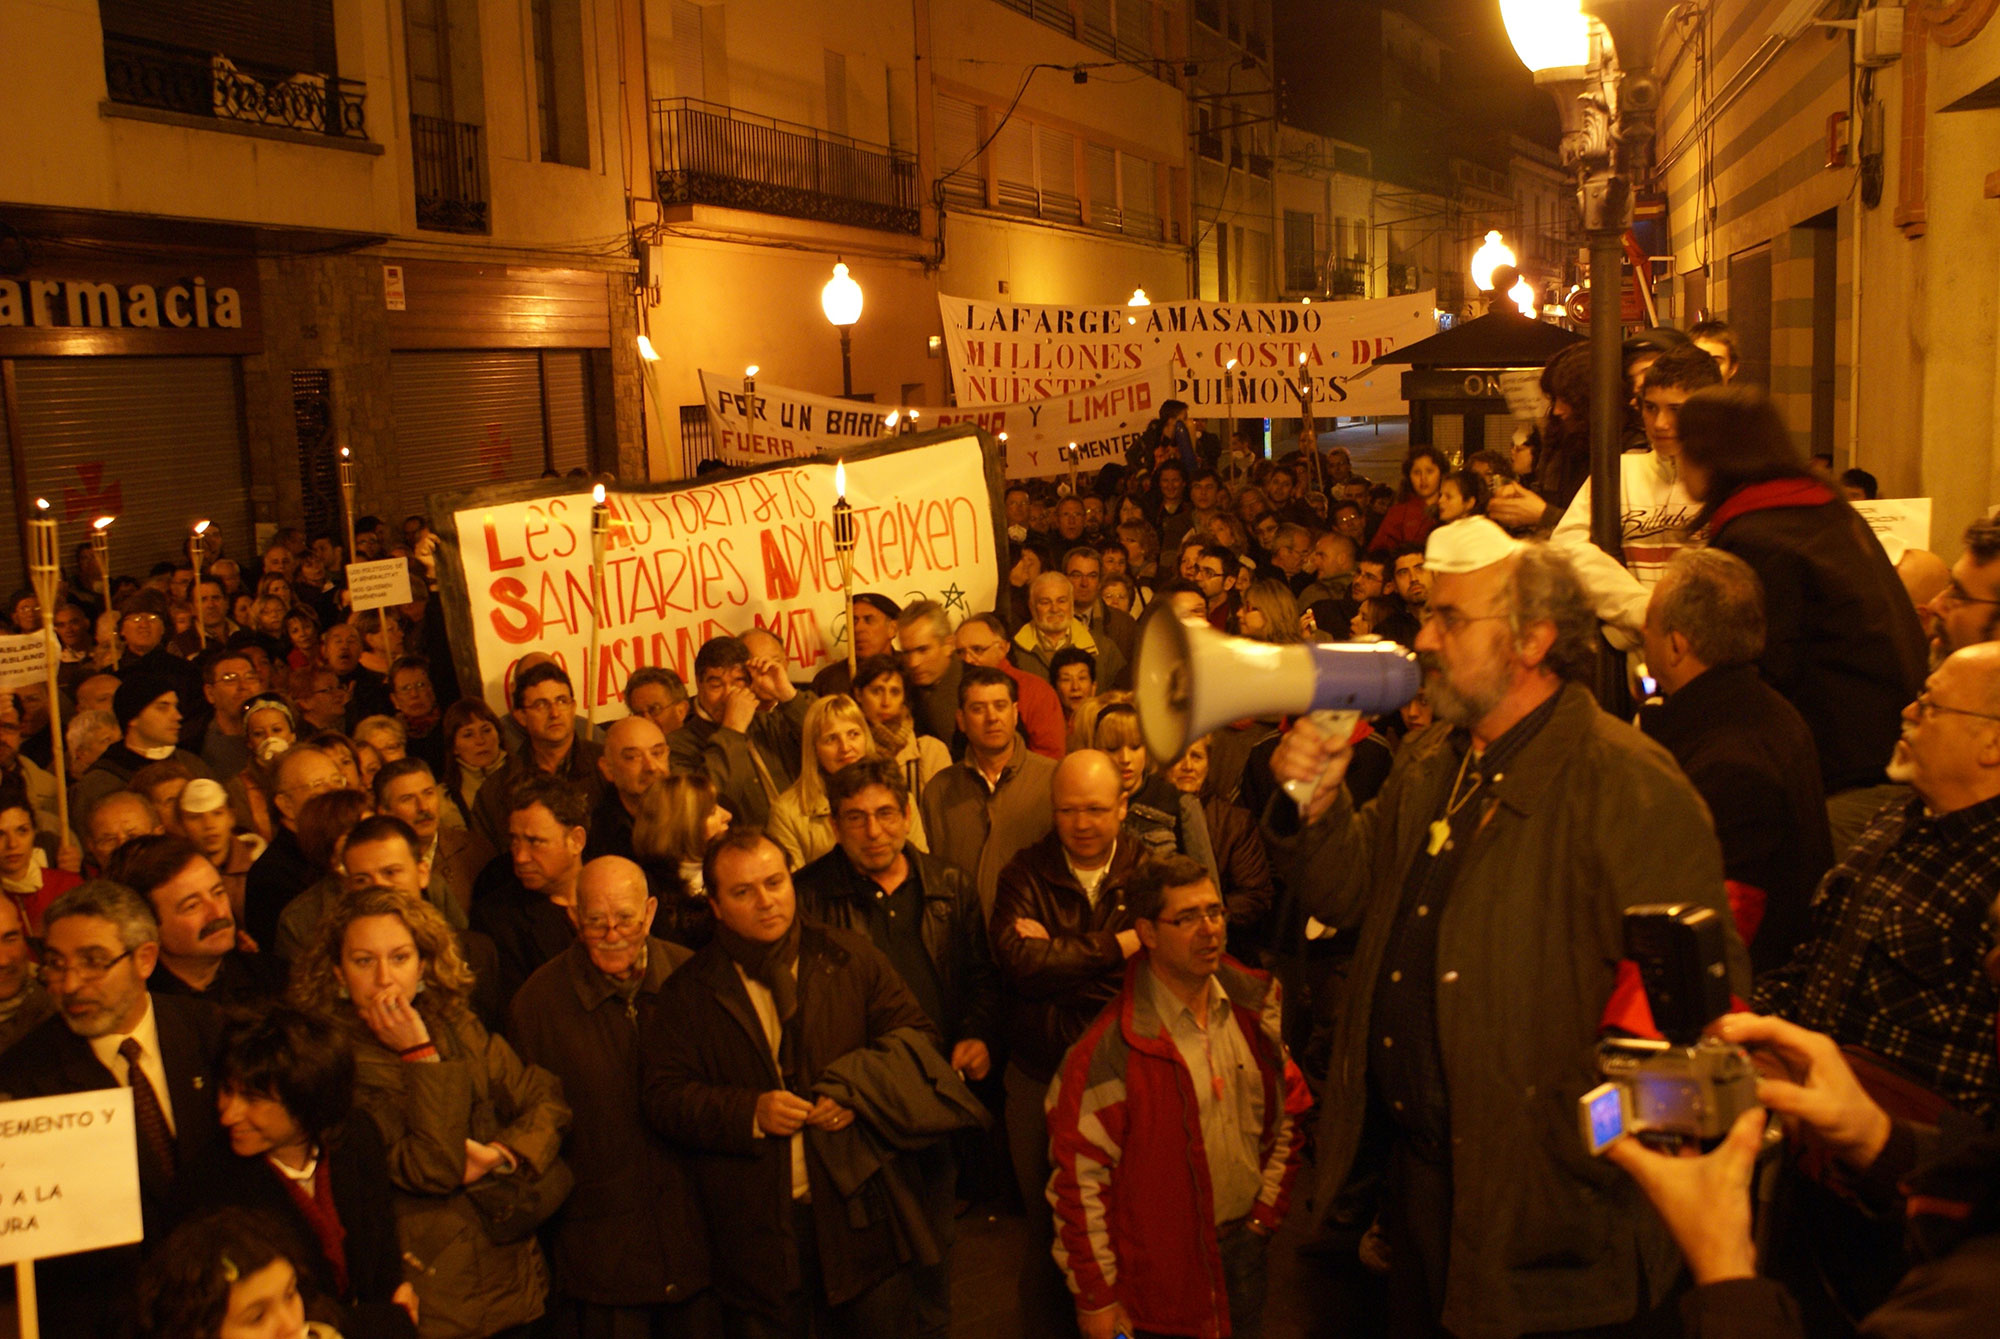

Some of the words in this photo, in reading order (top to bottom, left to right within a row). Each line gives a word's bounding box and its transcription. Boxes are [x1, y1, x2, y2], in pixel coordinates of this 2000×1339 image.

[0, 277, 242, 328] armacia
[967, 305, 1121, 334] LAFARGE
[1147, 306, 1321, 334] AMASANDO
[967, 340, 1142, 370] MILLONES
[1171, 342, 1187, 369] A
[1214, 341, 1323, 368] COSTA
[1352, 337, 1394, 365] DE
[718, 390, 767, 421] POR
[781, 402, 812, 431] UN
[1029, 405, 1042, 427] Y
[1068, 382, 1152, 424] LIMPIO
[722, 430, 795, 457] FUERA
[1027, 451, 1038, 466] Y
[102, 1108, 115, 1124] Y
[13, 1189, 28, 1206] A
[35, 1184, 62, 1202] LA
